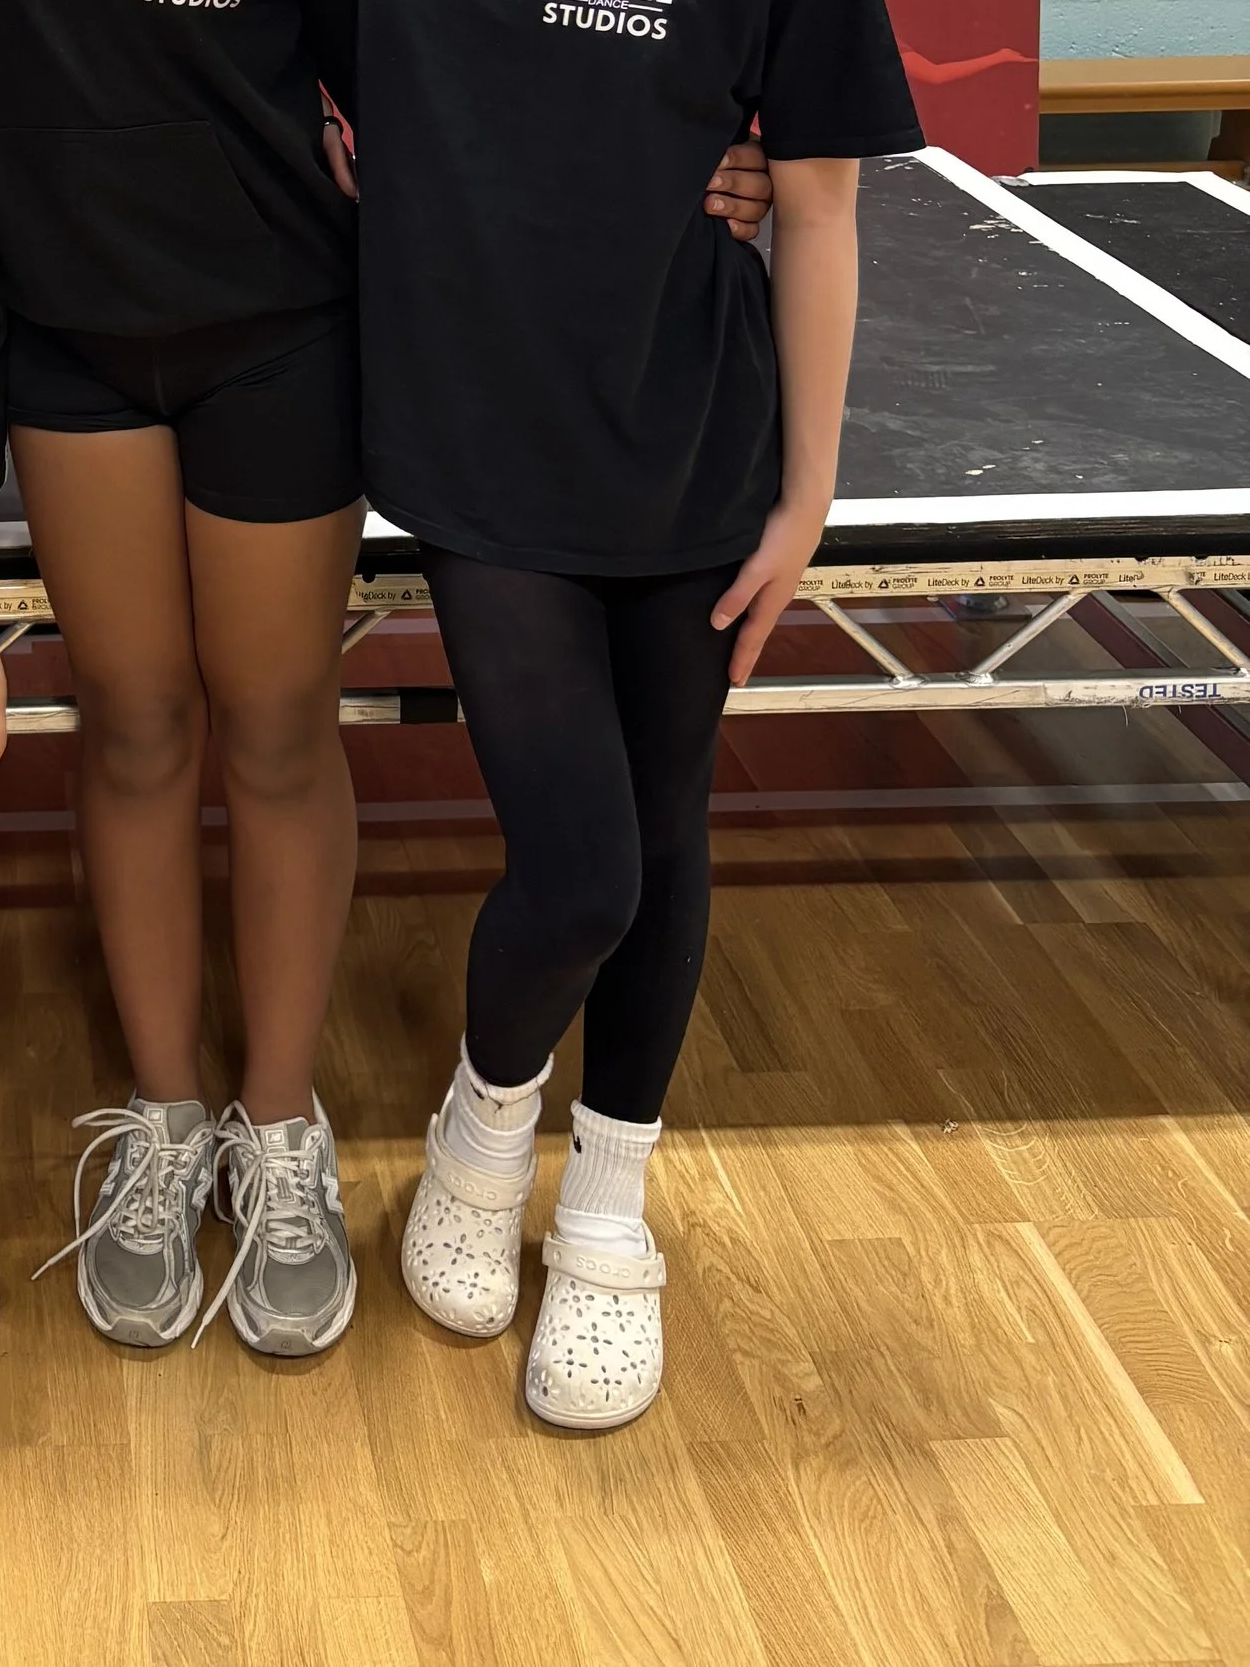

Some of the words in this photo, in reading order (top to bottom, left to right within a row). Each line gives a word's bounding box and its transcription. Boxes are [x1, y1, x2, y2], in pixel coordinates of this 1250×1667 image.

[542, 2, 668, 40] STUDIOS
[927, 578, 960, 587] LiteDeck
[961, 577, 970, 588] by
[1021, 576, 1054, 585] LiteDeck
[1055, 575, 1065, 586] by
[1213, 572, 1246, 582] LiteDeck
[1139, 683, 1222, 698] TESTED
[575, 1256, 631, 1278] crocs
